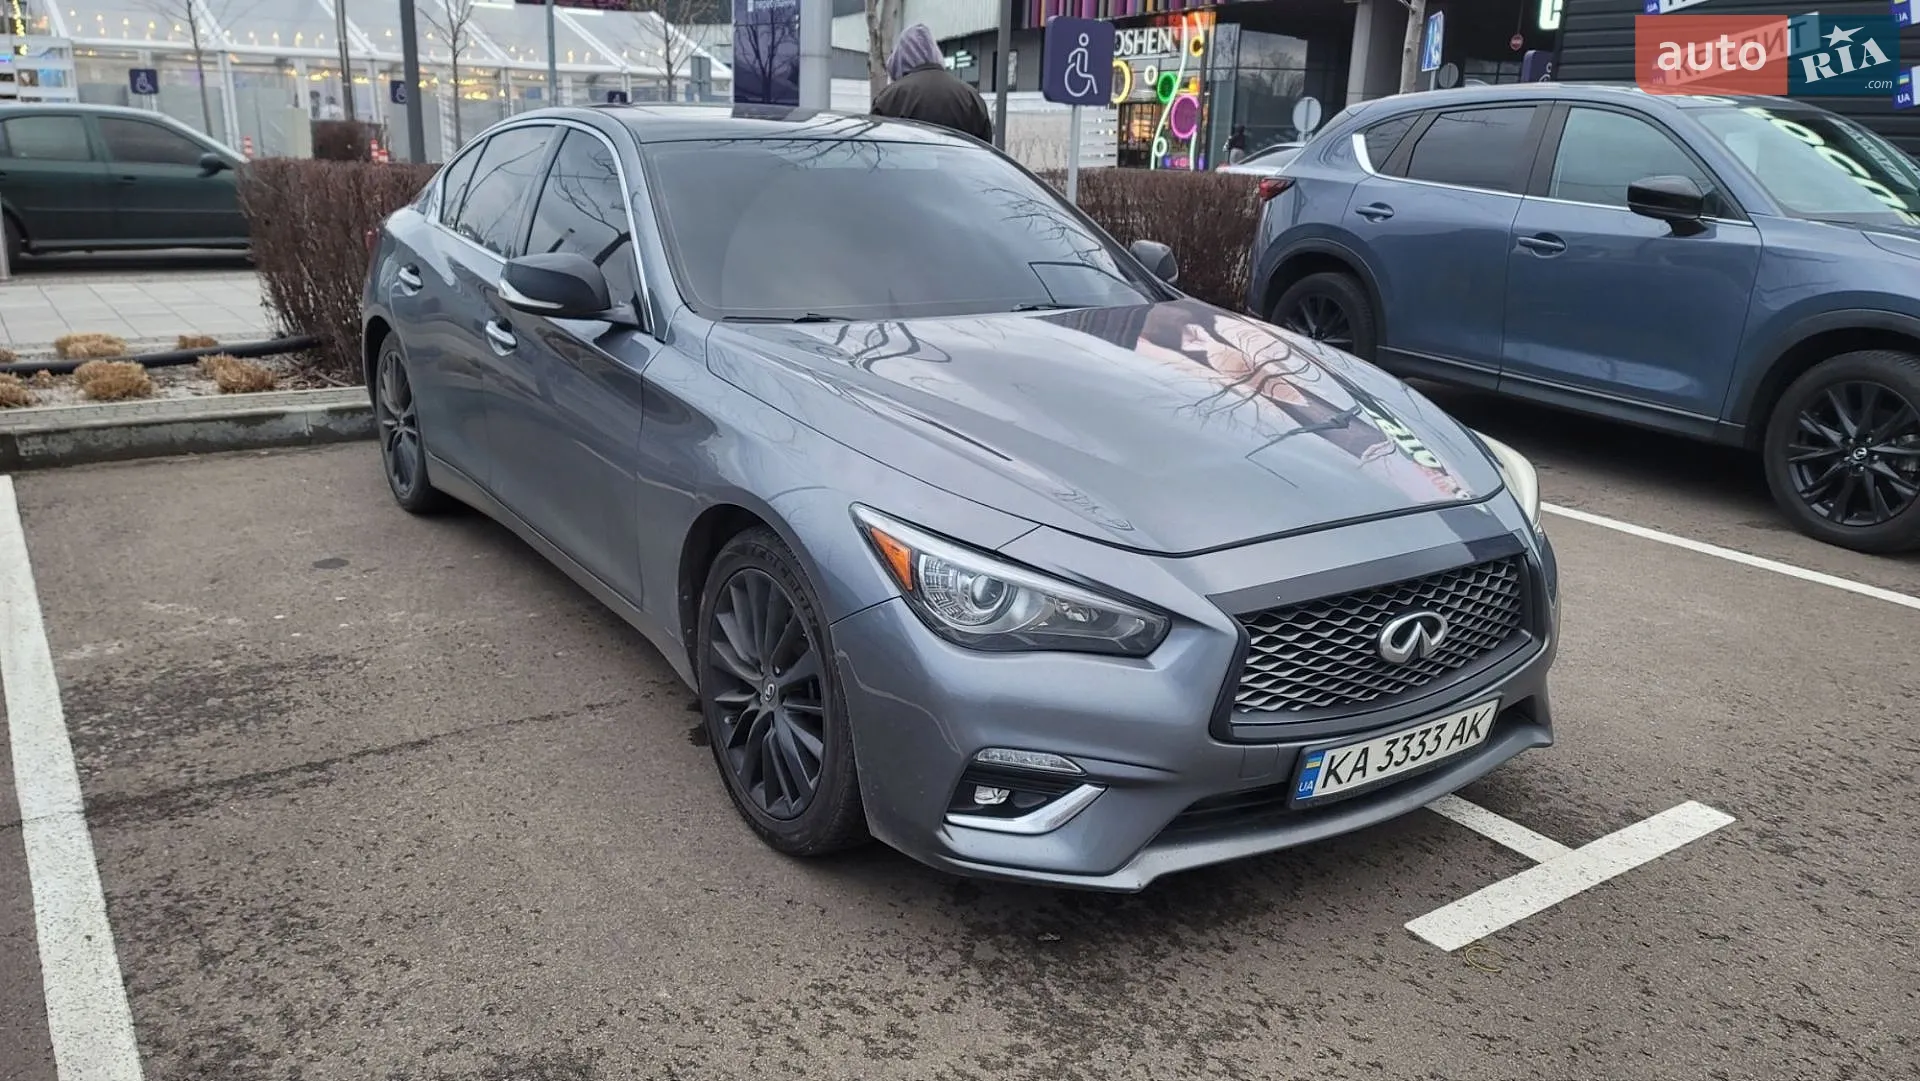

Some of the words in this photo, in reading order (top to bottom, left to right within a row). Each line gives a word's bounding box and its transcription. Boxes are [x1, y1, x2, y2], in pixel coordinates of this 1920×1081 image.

[1113, 27, 1172, 56] OSHEN
[1897, 93, 1911, 104] UA
[1377, 722, 1449, 772] 3333
[1298, 780, 1314, 793] UA
